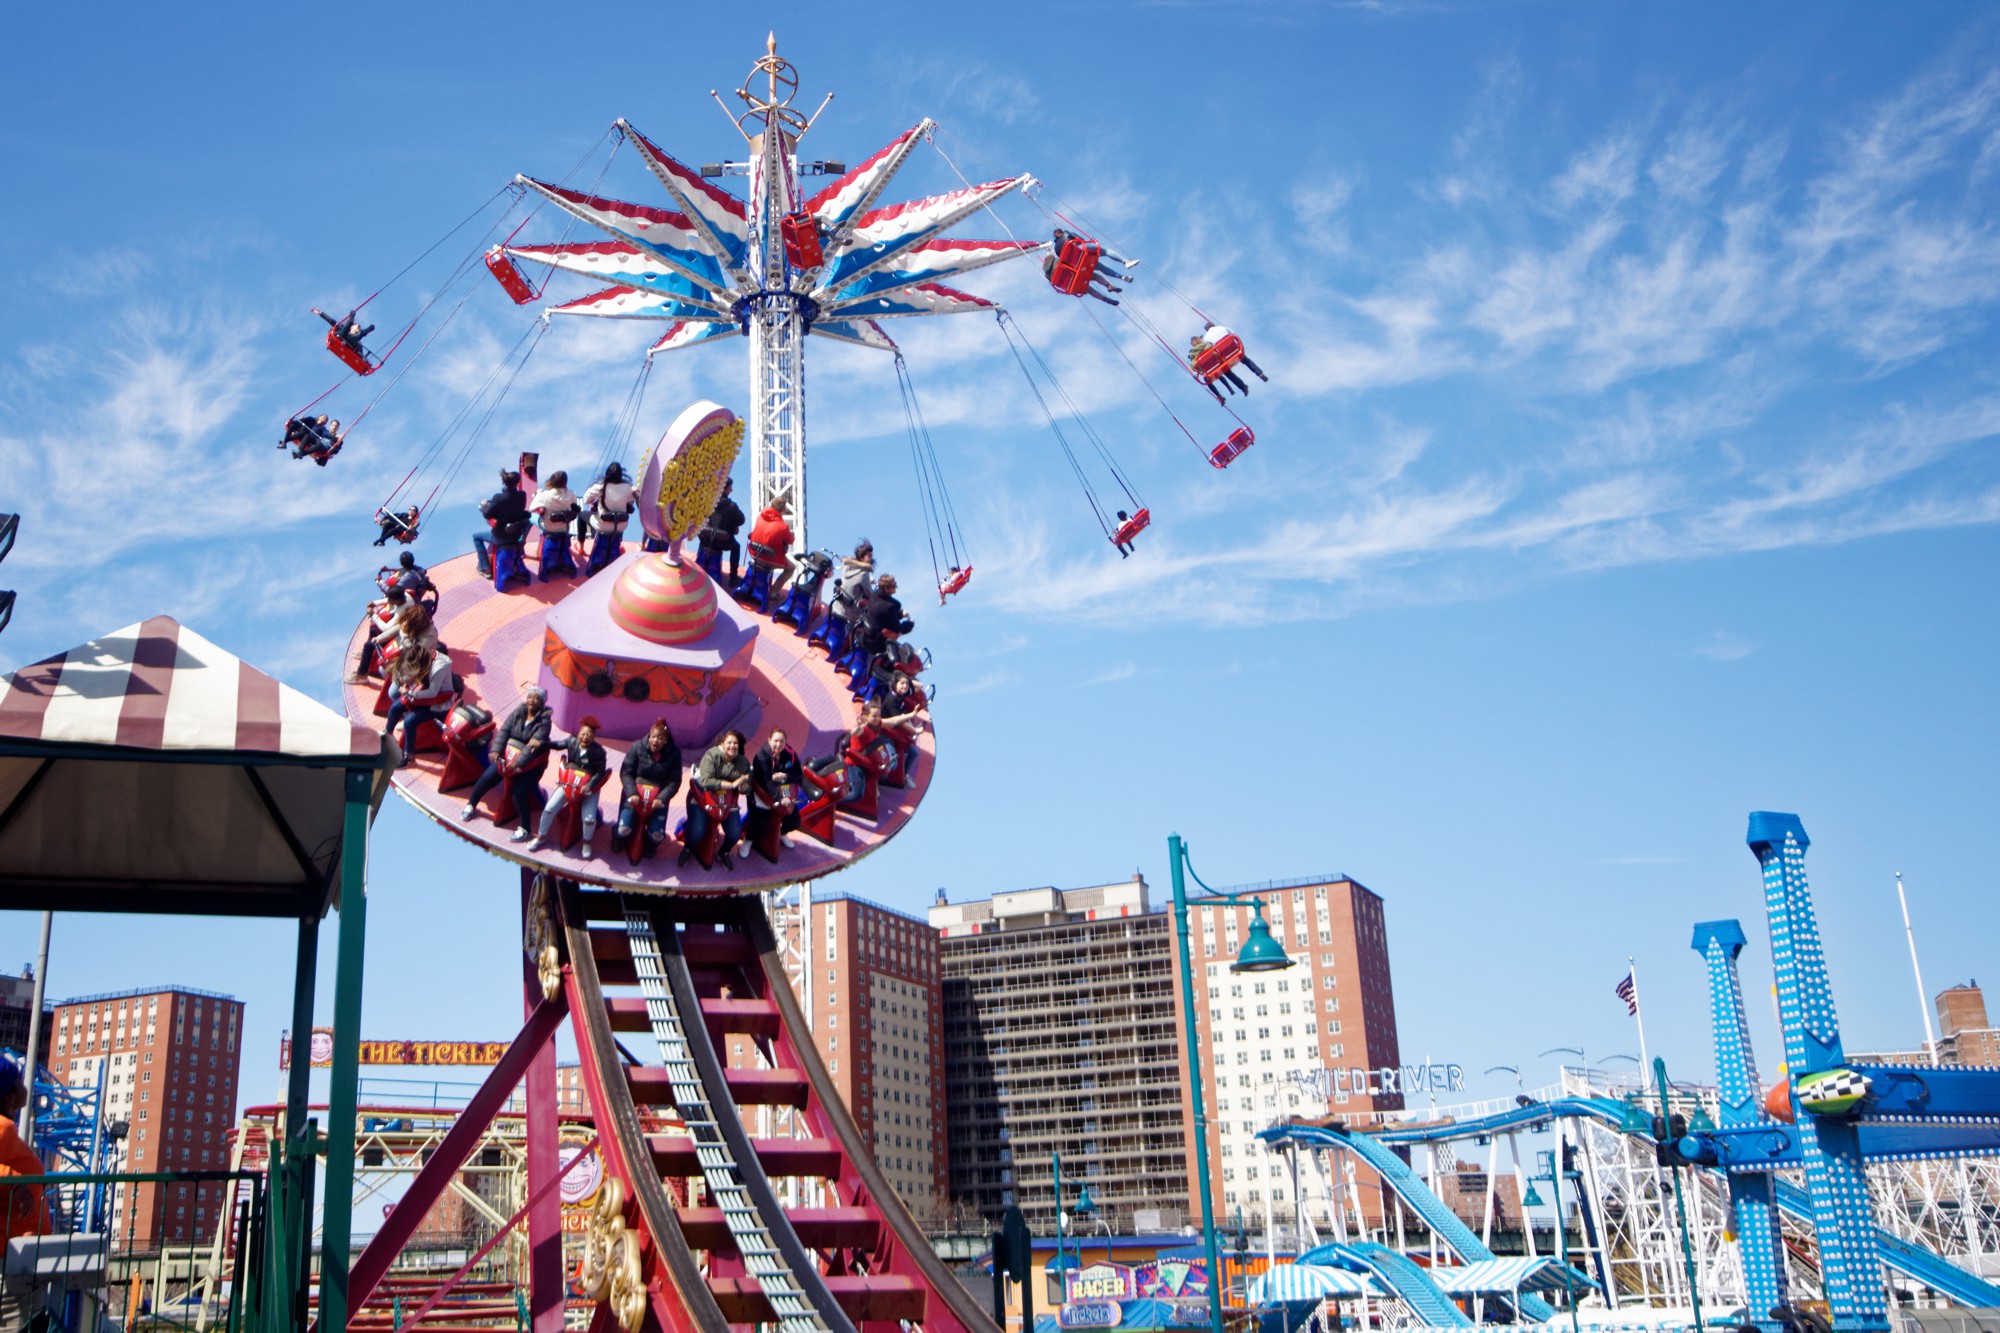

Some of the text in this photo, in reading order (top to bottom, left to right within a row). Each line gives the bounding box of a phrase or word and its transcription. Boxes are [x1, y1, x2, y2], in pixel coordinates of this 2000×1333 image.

[1295, 1064, 1465, 1097] WILD RIVER
[1072, 1277, 1125, 1299] RACER
[1068, 1304, 1111, 1325] Tickets
